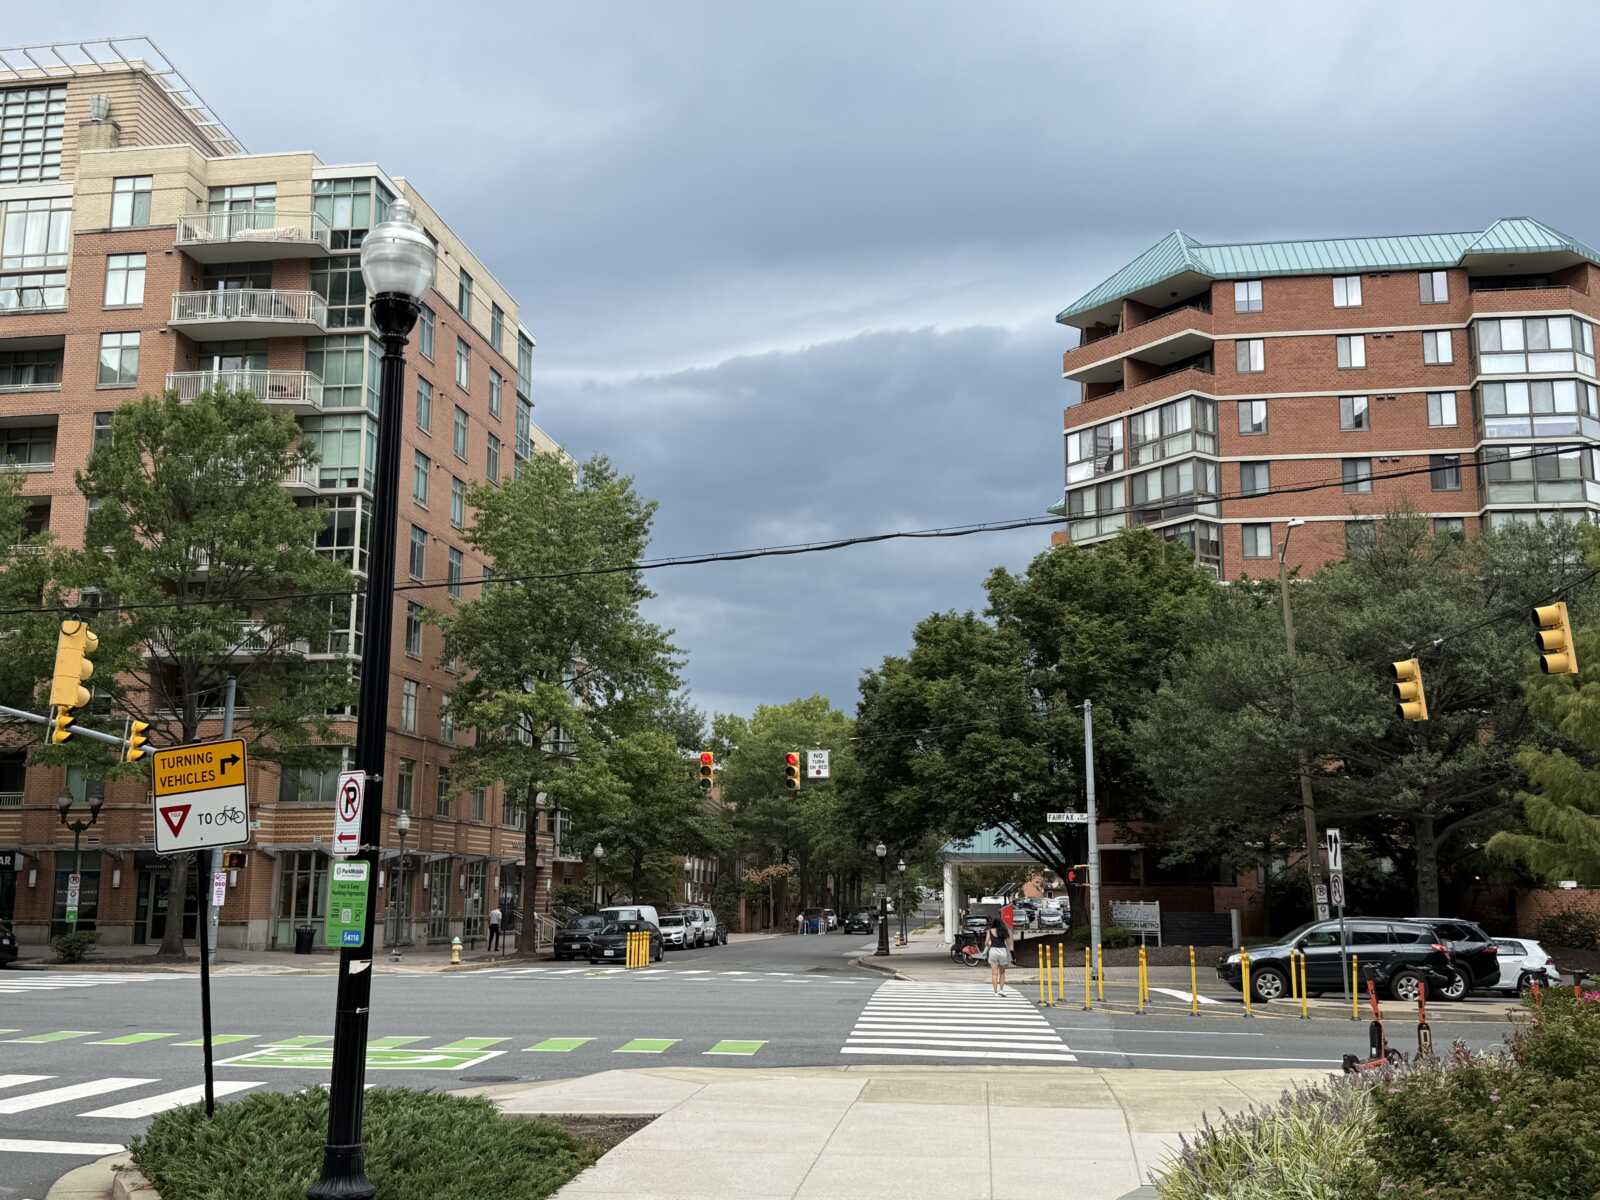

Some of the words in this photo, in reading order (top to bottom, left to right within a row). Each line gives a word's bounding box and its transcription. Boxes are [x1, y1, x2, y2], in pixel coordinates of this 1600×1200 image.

[160, 752, 213, 770] TURNING
[160, 770, 216, 788] VEHICLES
[197, 813, 212, 825] TO
